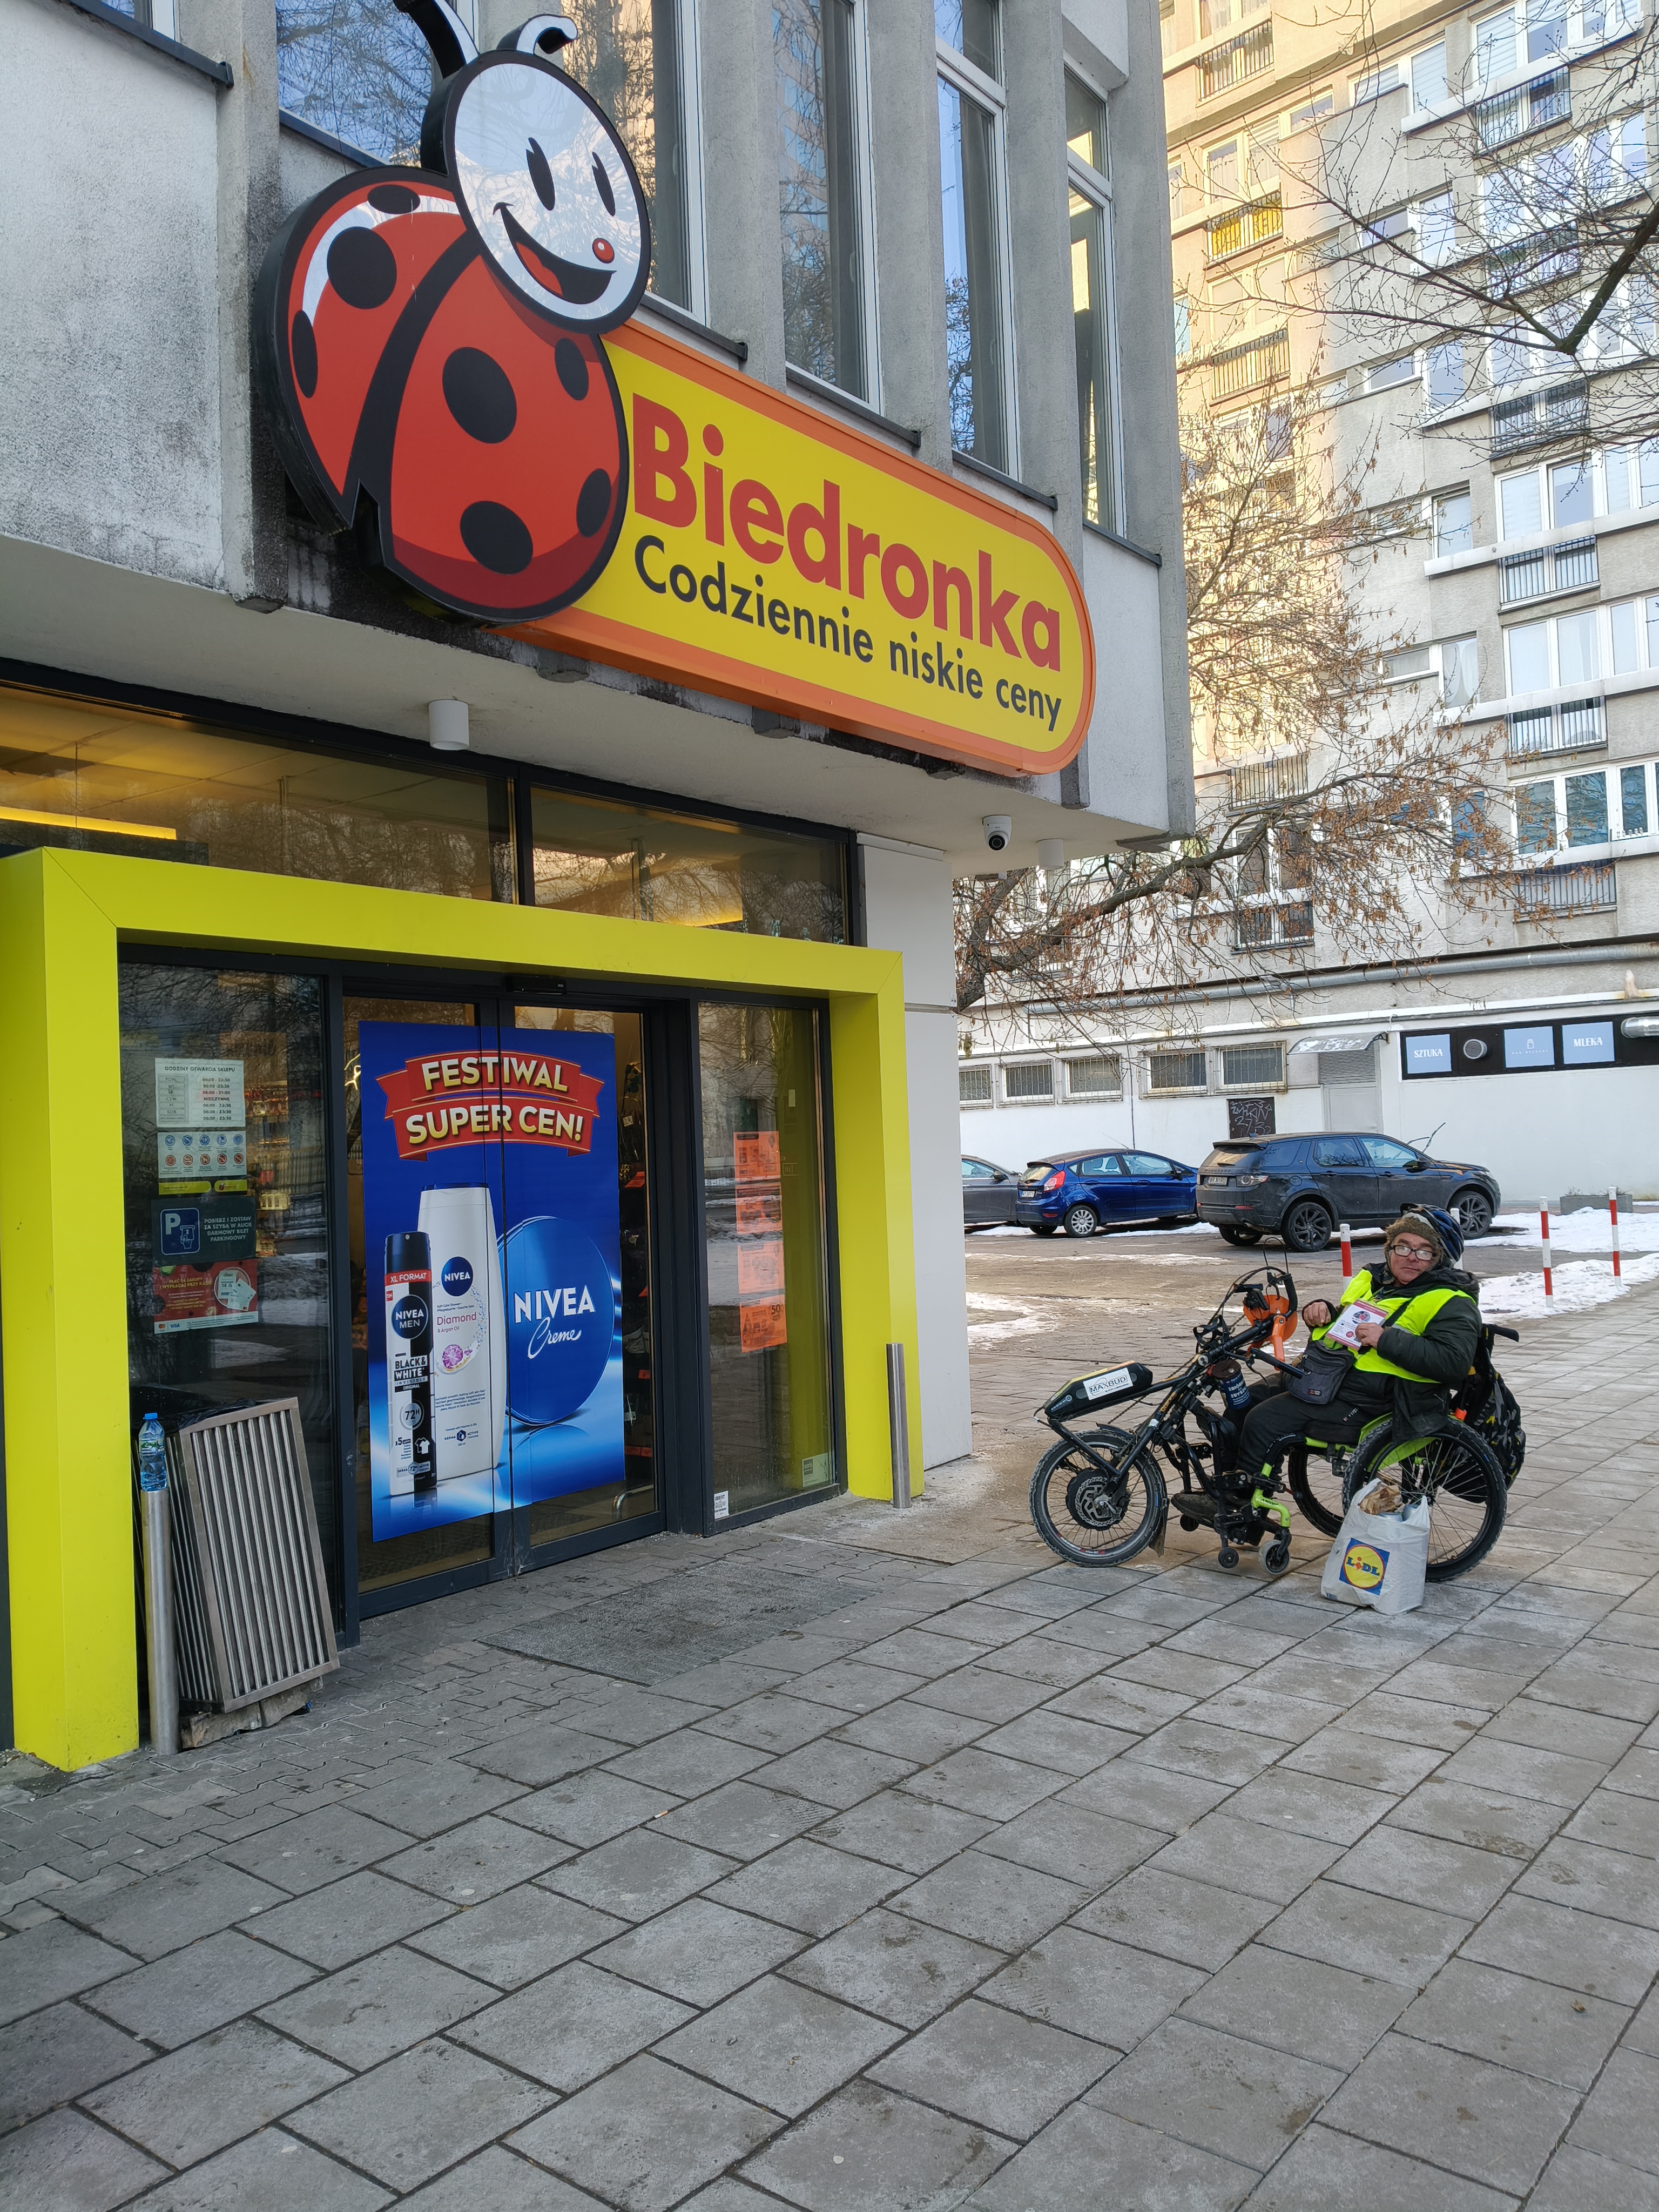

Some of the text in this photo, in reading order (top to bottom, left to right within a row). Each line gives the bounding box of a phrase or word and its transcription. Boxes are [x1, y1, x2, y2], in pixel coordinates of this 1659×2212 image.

[633, 393, 1061, 672] Biedronka
[635, 535, 1062, 732] Codziennie niskie ceny
[1573, 1037, 1603, 1047] MLEKA
[1413, 1048, 1443, 1058] SZTUKA
[421, 1056, 568, 1092] FESTIWAL
[406, 1104, 583, 1144] SUPER CEN!
[165, 1213, 180, 1235] P
[399, 1272, 427, 1282] FORMAT
[444, 1272, 470, 1282] NIVEA
[514, 1285, 596, 1323] NIVEA
[771, 1304, 781, 1314] 50
[395, 1309, 424, 1320] NIVEA
[437, 1311, 477, 1325] Diamond
[400, 1319, 420, 1329] MEN
[528, 1316, 582, 1359] Creme
[395, 1367, 422, 1380] WHITE
[1090, 1377, 1126, 1393] MAXBUD
